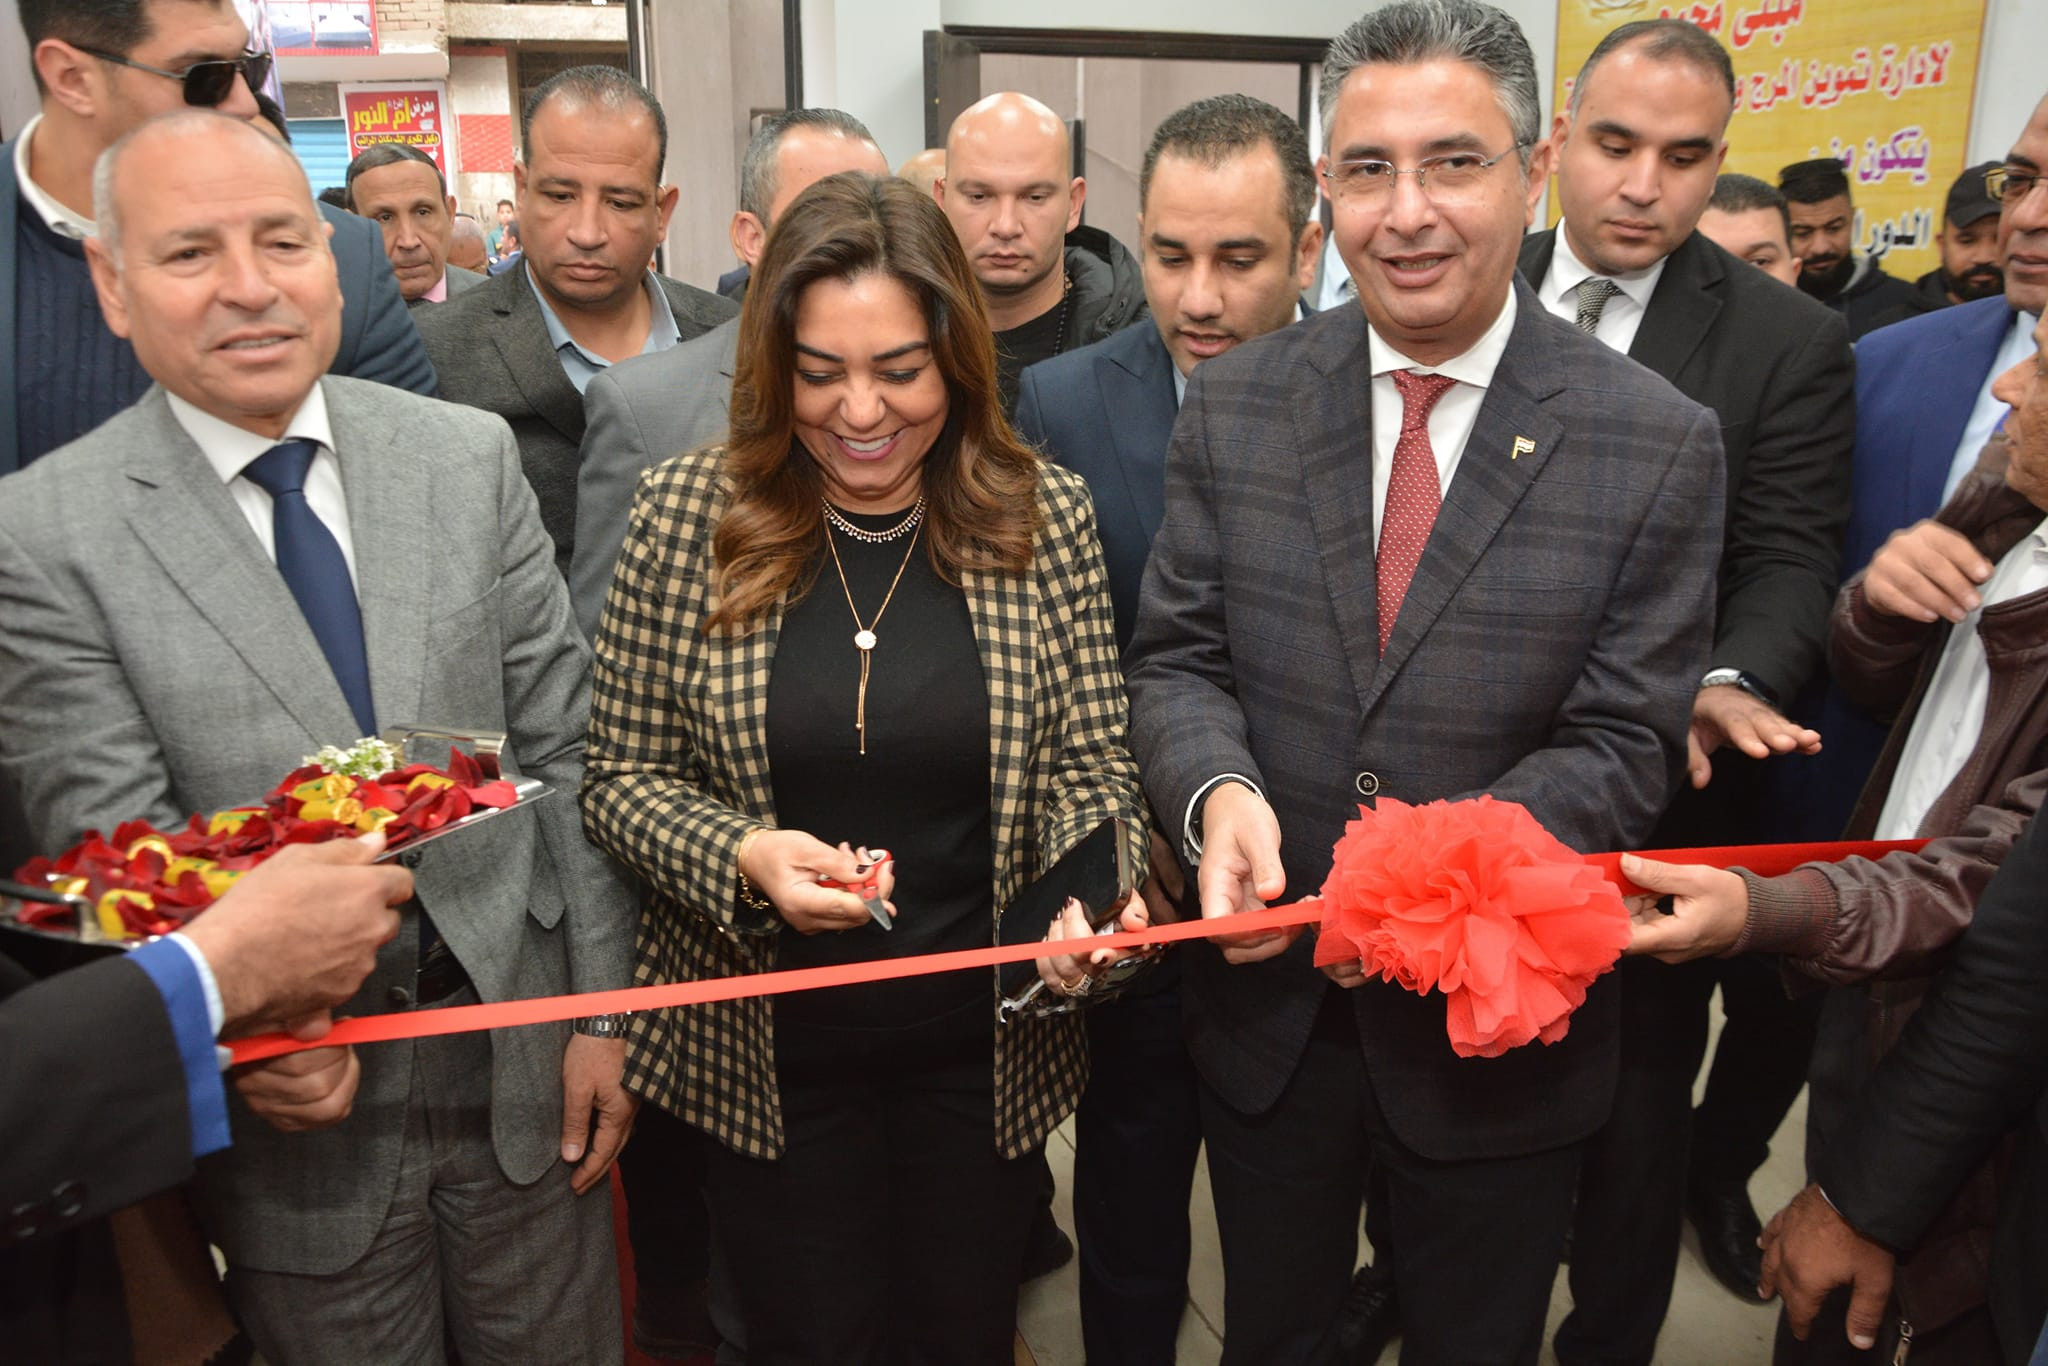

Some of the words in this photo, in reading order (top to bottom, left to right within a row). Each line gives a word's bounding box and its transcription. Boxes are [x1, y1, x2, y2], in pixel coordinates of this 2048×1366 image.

[1750, 58, 1799, 111] المرج
[1801, 50, 1872, 109] تموين
[353, 102, 388, 131] النور
[1856, 125, 1929, 184] يتكون
